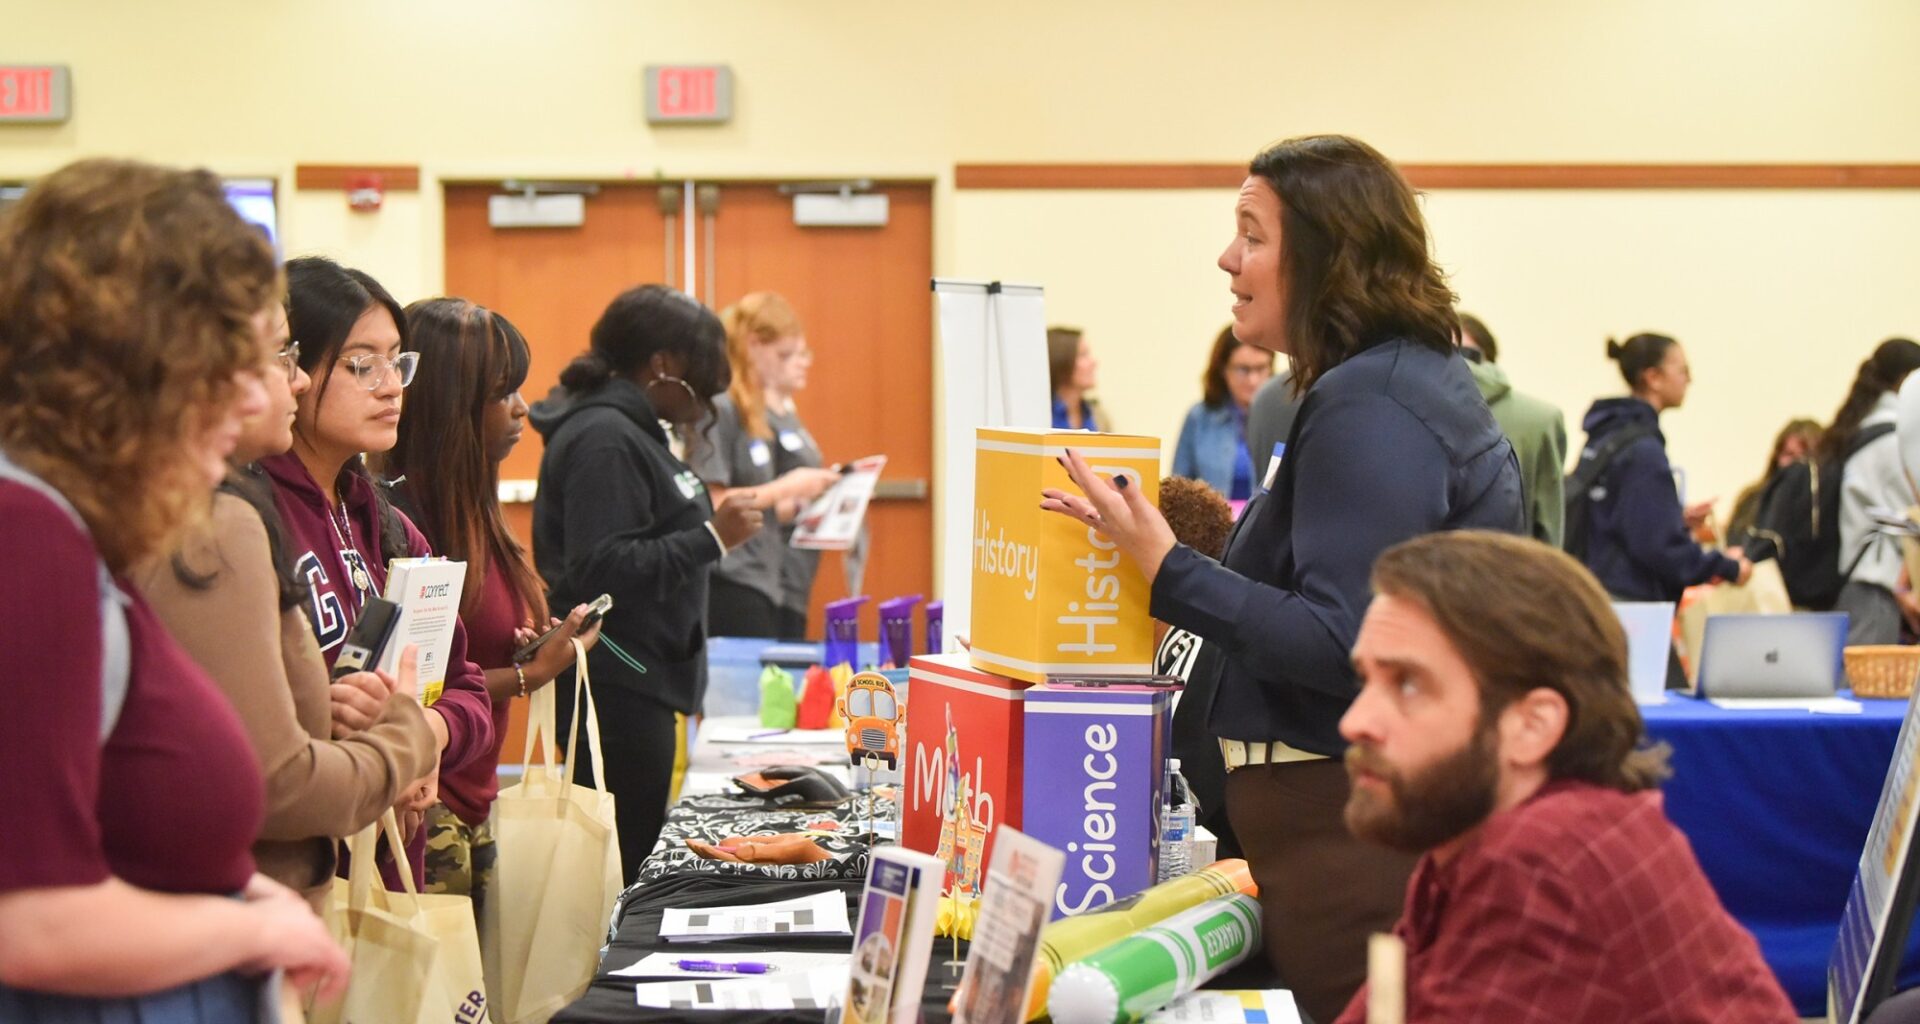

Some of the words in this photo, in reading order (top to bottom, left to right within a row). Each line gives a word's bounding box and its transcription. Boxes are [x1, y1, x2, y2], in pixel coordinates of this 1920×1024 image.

[0, 67, 53, 115] EXIT
[658, 67, 718, 115] EXIT
[974, 508, 1038, 600] History
[1057, 465, 1142, 656] Histy
[913, 741, 993, 833] Mth
[1056, 723, 1118, 916] Science
[1202, 918, 1244, 959] MARKER
